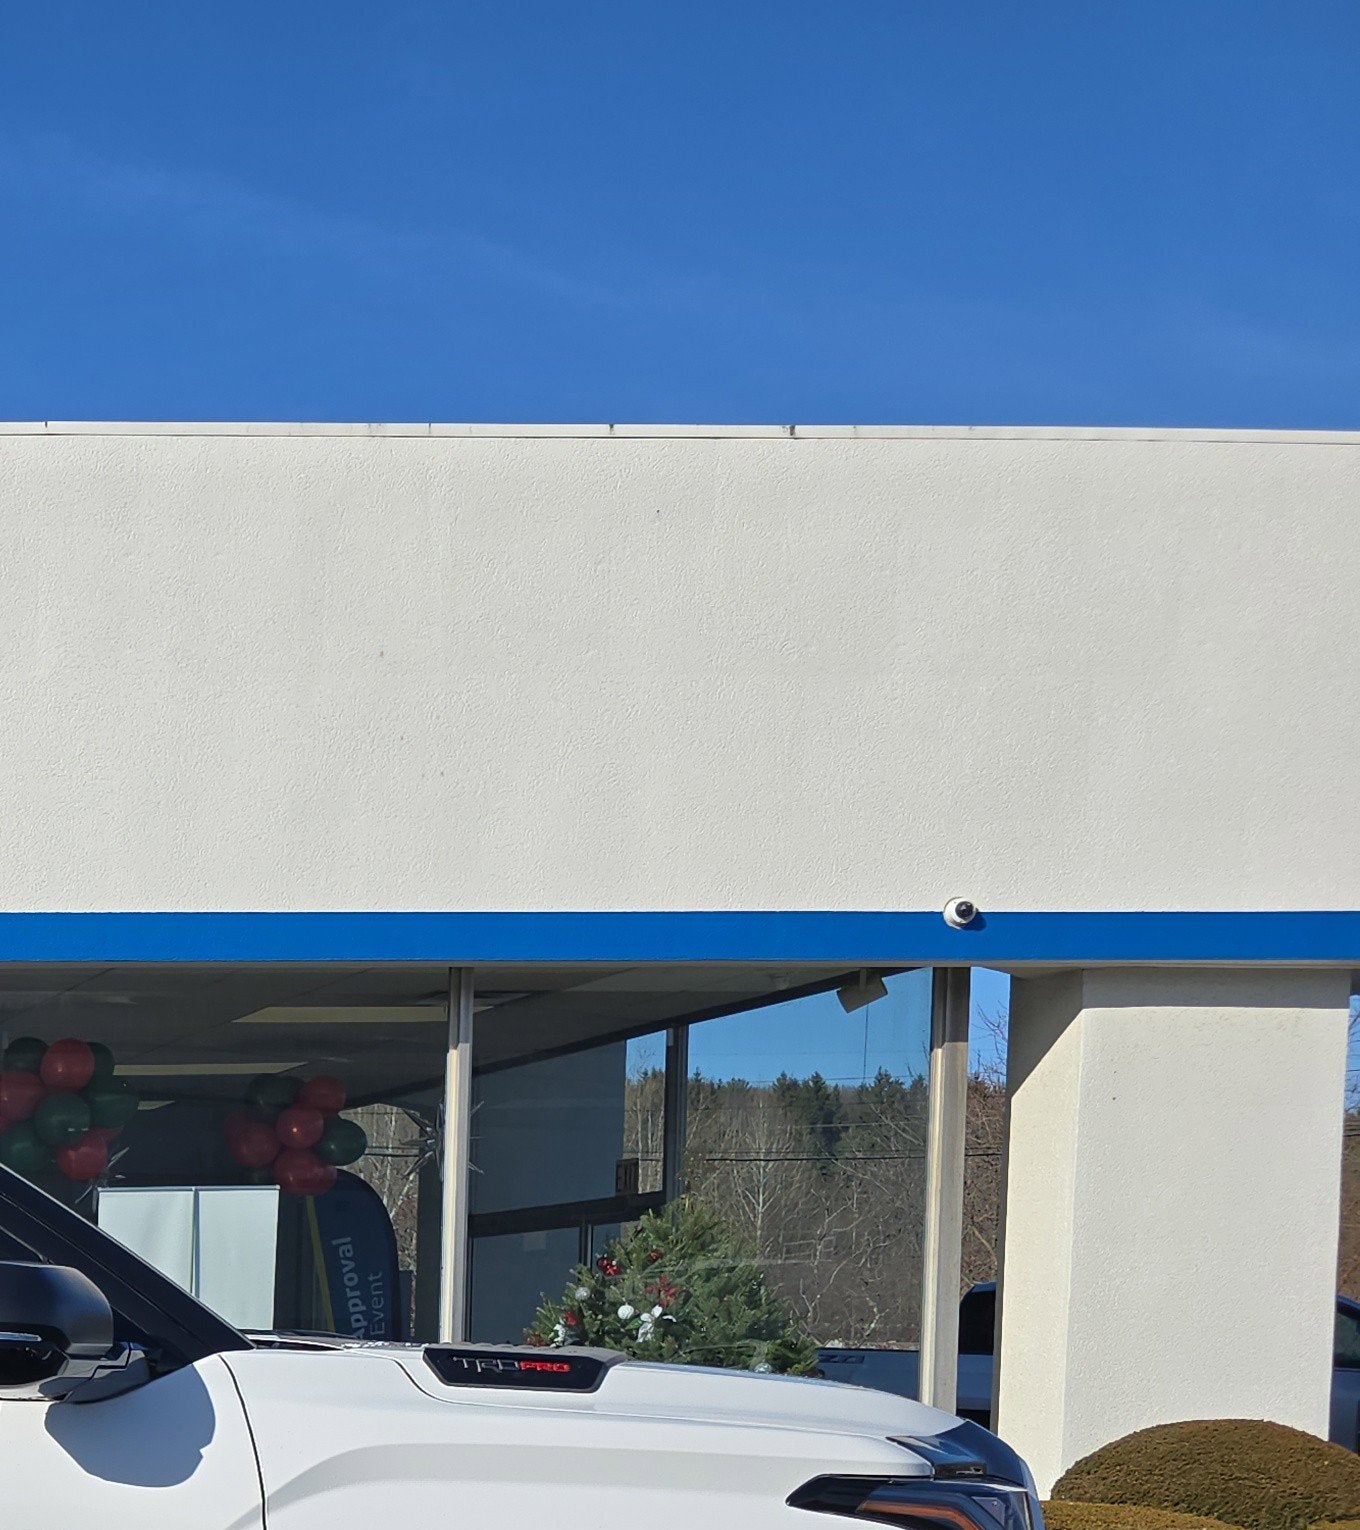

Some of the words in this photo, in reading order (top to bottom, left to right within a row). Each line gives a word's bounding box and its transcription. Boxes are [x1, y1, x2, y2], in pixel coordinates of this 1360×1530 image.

[367, 1270, 386, 1336] Event
[452, 1356, 519, 1373] TRD
[520, 1360, 571, 1373] PRO
